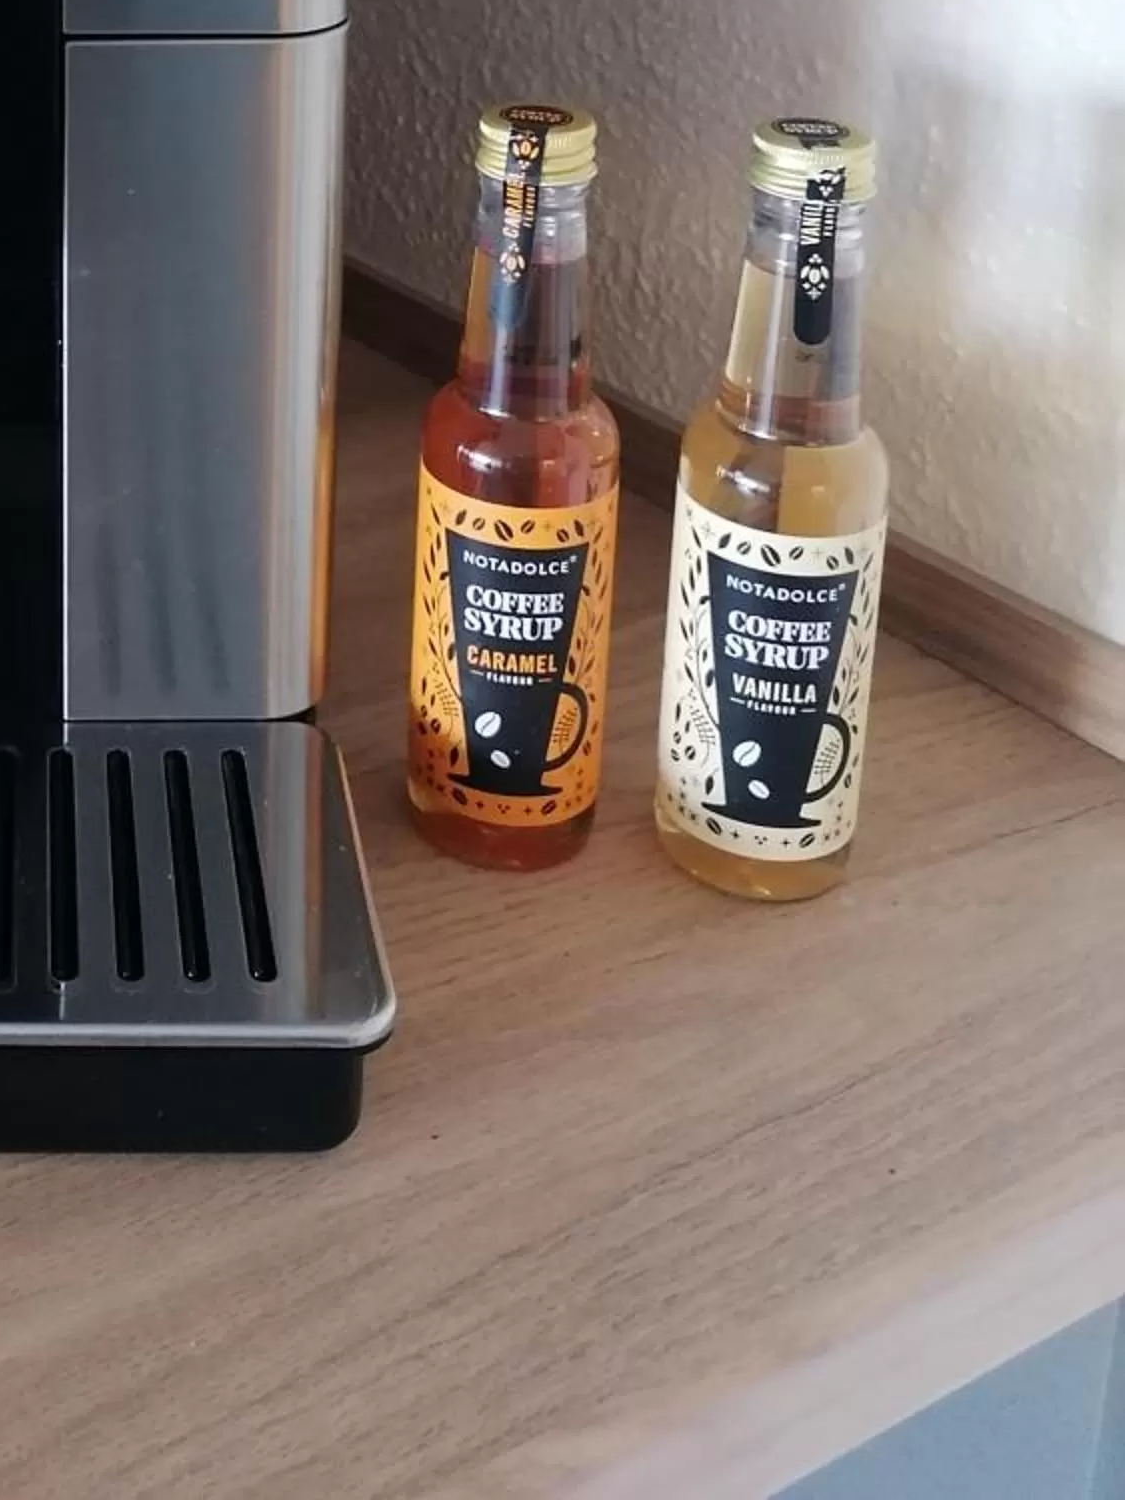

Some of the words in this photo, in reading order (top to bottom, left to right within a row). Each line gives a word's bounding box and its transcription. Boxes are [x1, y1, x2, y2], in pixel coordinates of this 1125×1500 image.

[465, 584, 564, 615] COFFEE
[464, 607, 563, 641] SYRUP
[728, 609, 832, 643] COFFEE
[466, 644, 558, 674] CARAMEL
[725, 633, 830, 671] SYRUP
[732, 672, 817, 704] VANILLA
